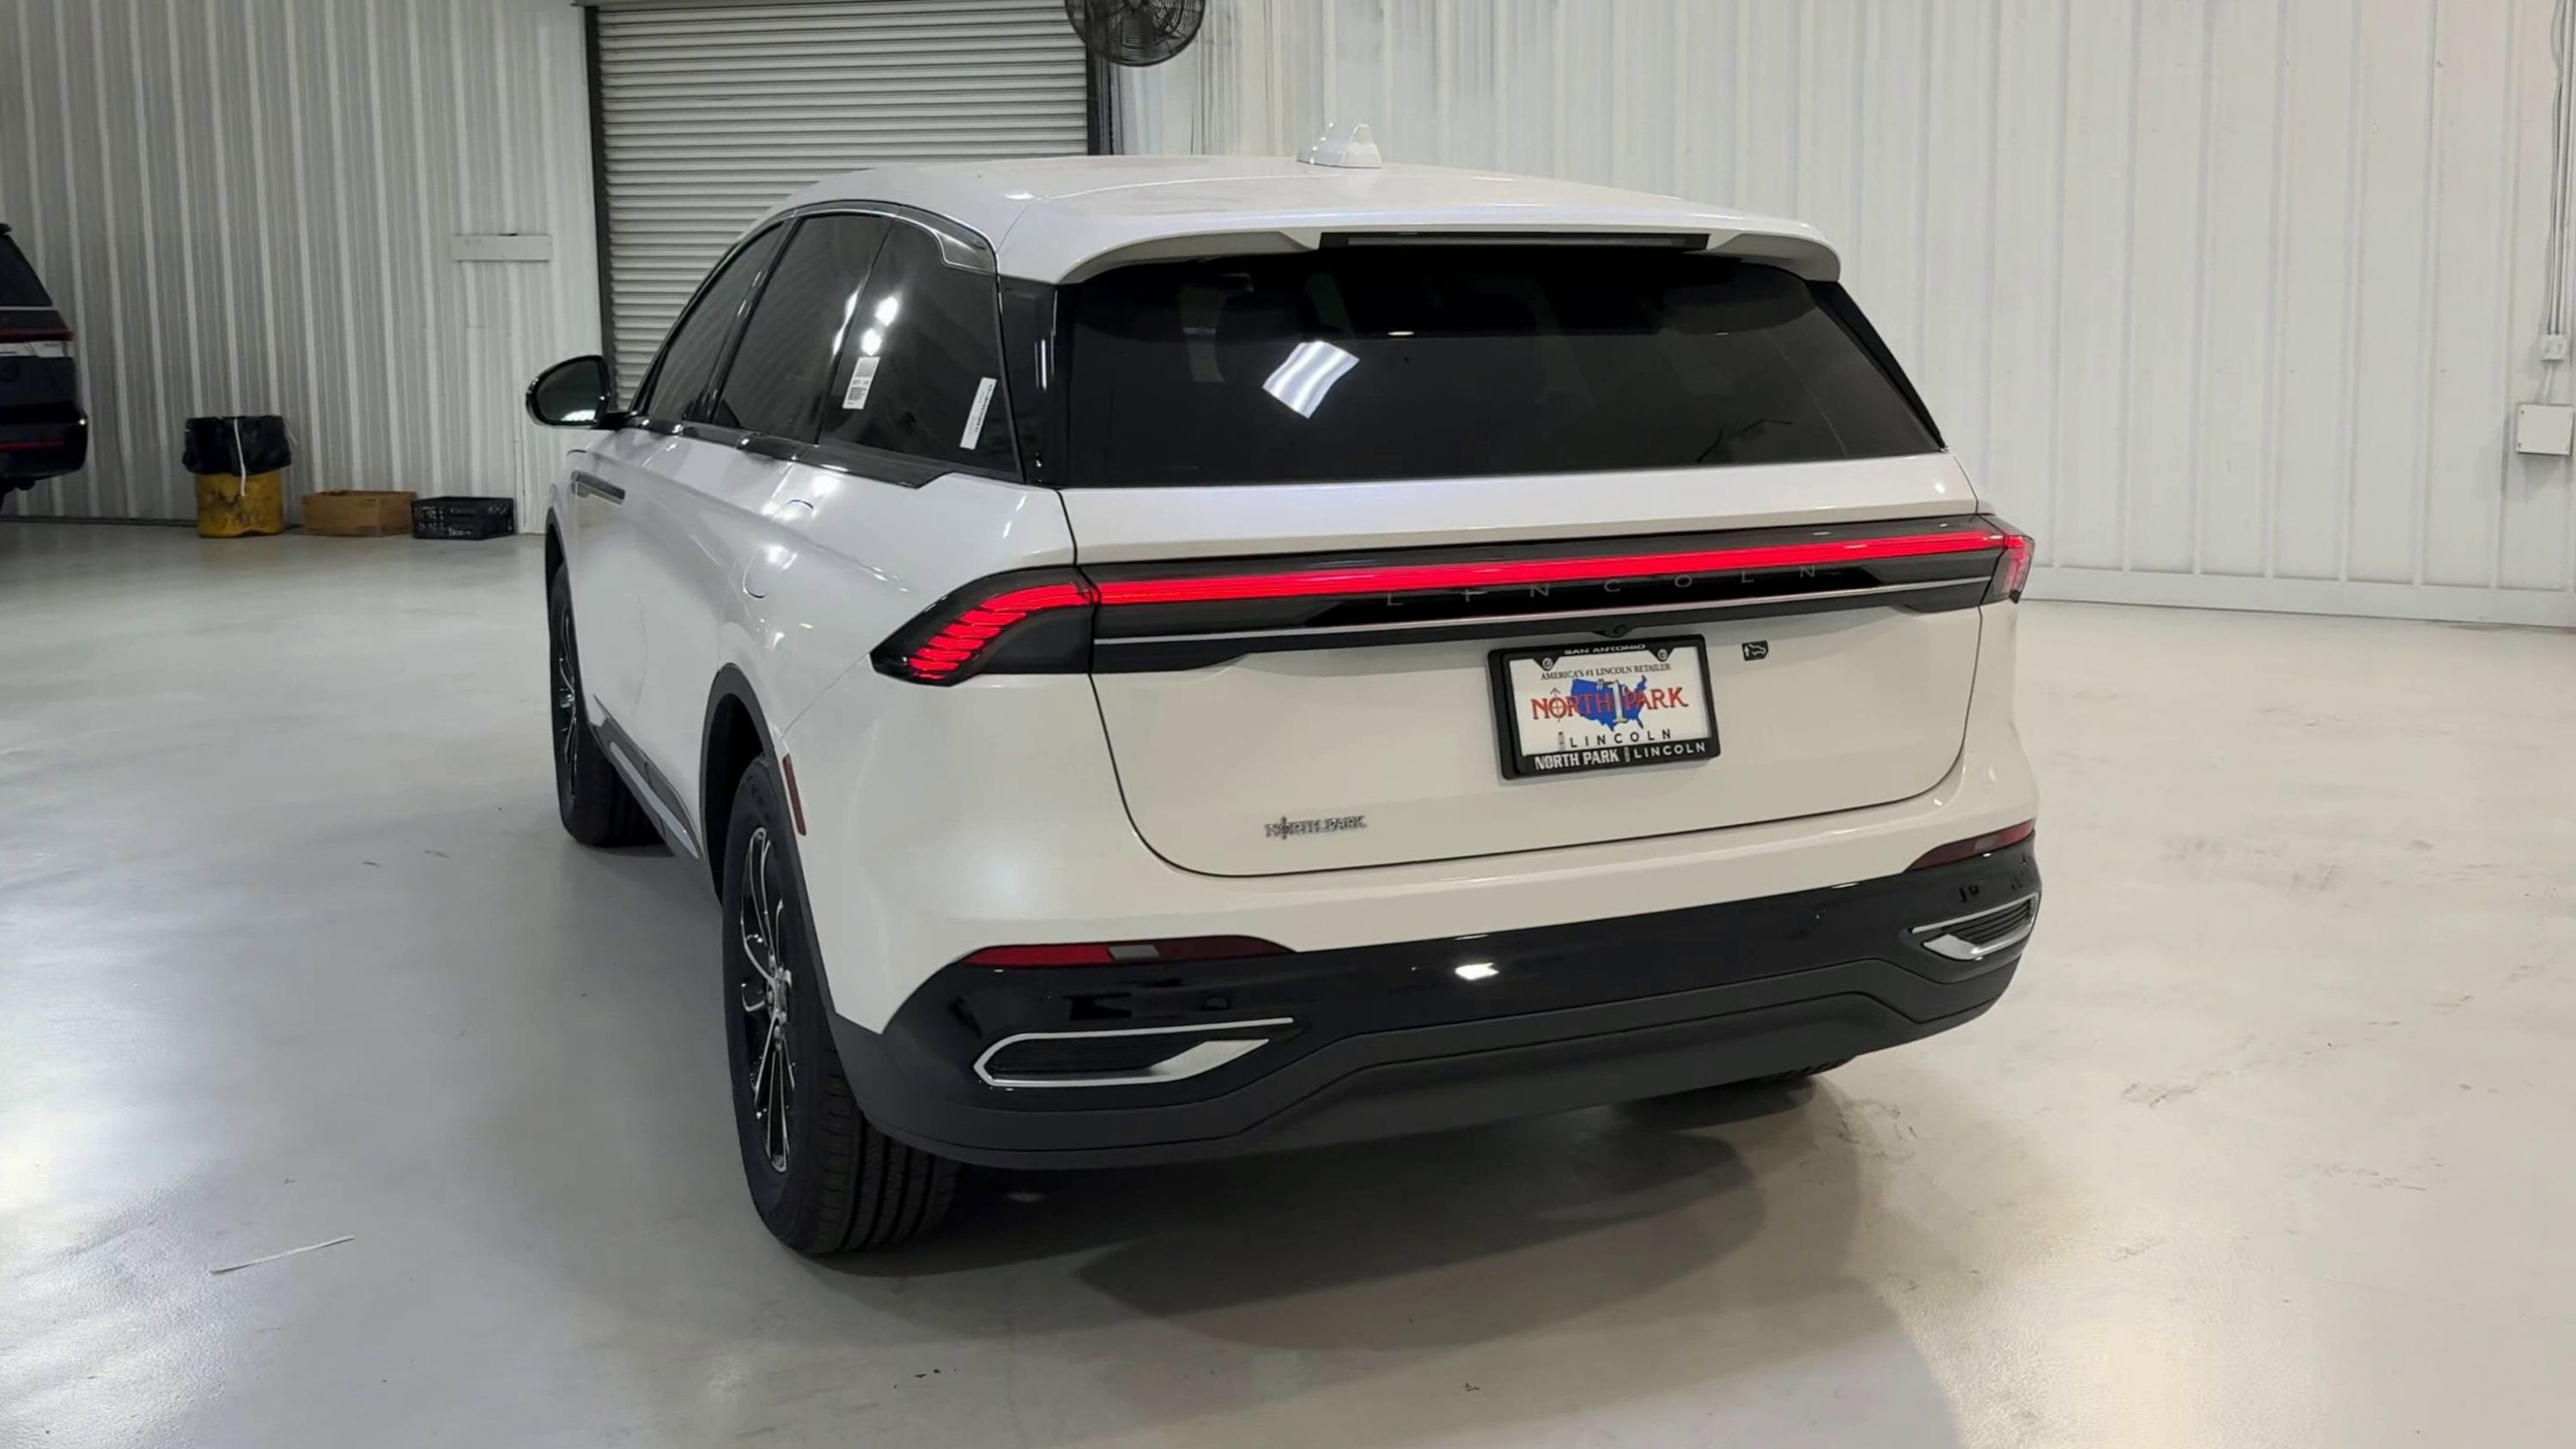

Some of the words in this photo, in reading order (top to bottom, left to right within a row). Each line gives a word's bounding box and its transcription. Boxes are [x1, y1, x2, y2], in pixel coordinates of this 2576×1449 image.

[1386, 566, 1816, 606] LINCOLN
[1593, 644, 1646, 653] ANTONIO
[1540, 669, 1584, 680] AMERICA'S
[1586, 668, 1595, 676] #1
[1595, 665, 1633, 676] LINCOLN
[1634, 663, 1672, 674] RETAILER
[1530, 689, 1614, 721] NORTH
[1623, 686, 1689, 711] PARK
[1570, 729, 1672, 749] LINCOLN
[1534, 751, 1581, 771] NORTH
[1582, 749, 1619, 765] PARK
[1634, 742, 1706, 759] LINCOLN
[1263, 818, 1321, 839] NORTH
[1323, 815, 1368, 831] PARK
